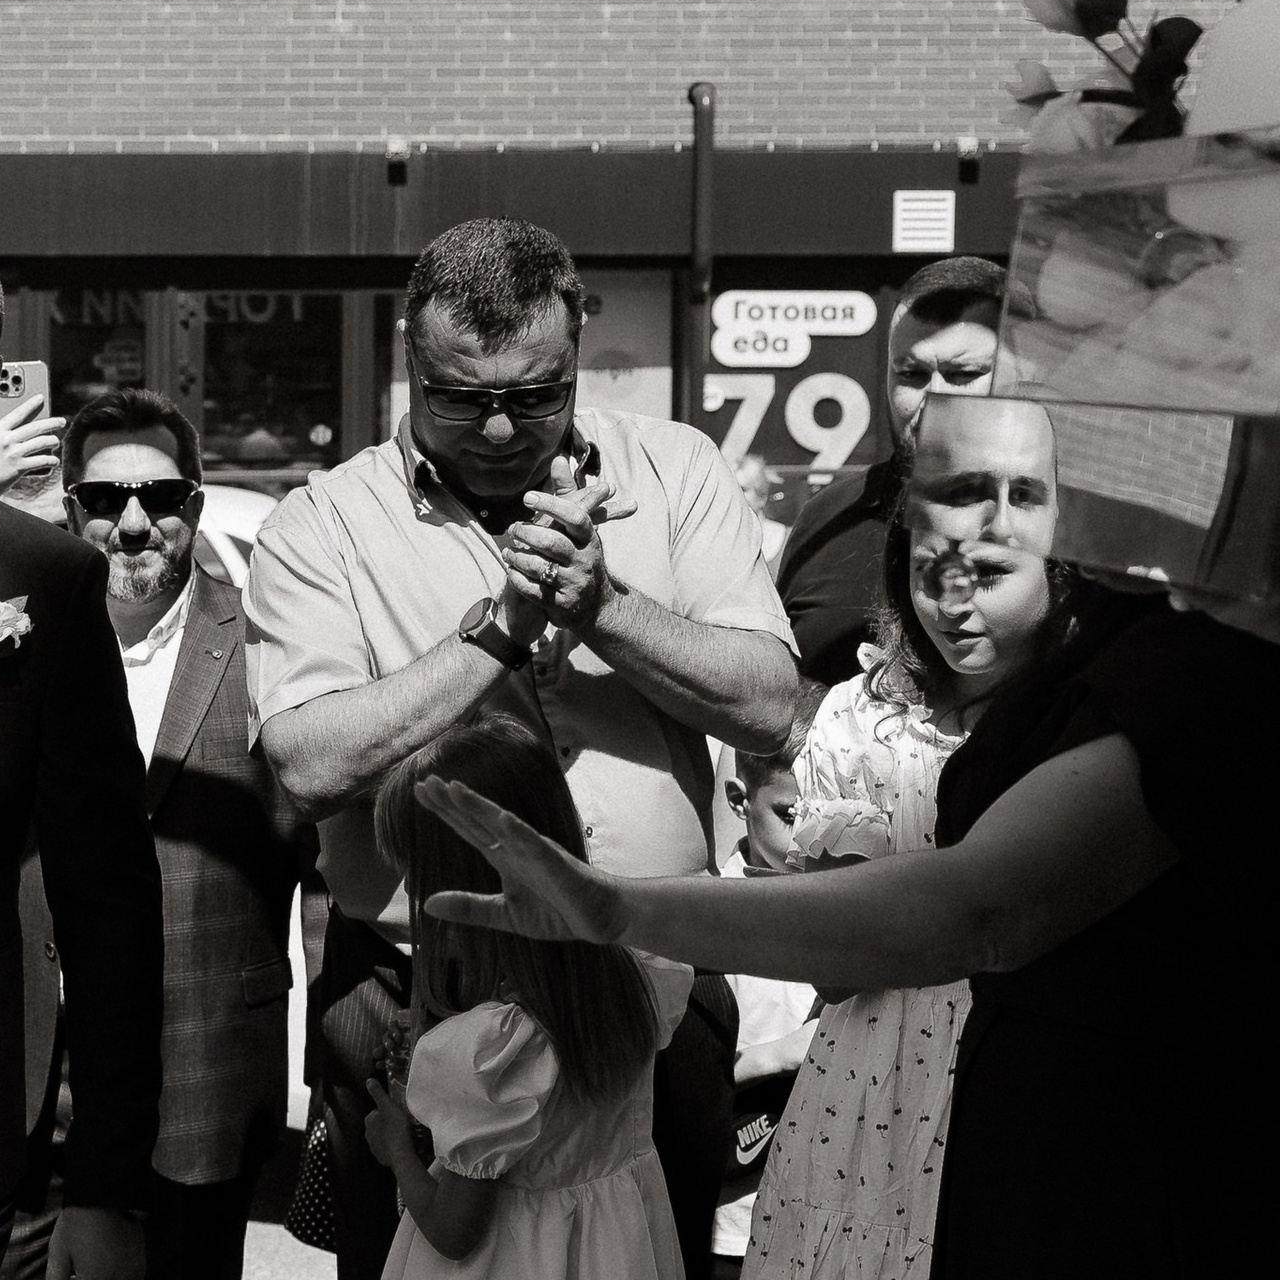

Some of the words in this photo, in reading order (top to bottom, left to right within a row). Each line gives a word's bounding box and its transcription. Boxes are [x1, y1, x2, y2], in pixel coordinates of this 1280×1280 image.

[733, 300, 856, 321] Готовая
[733, 329, 789, 353] еда
[703, 372, 871, 473] 79
[736, 1113, 773, 1149] NIKE
